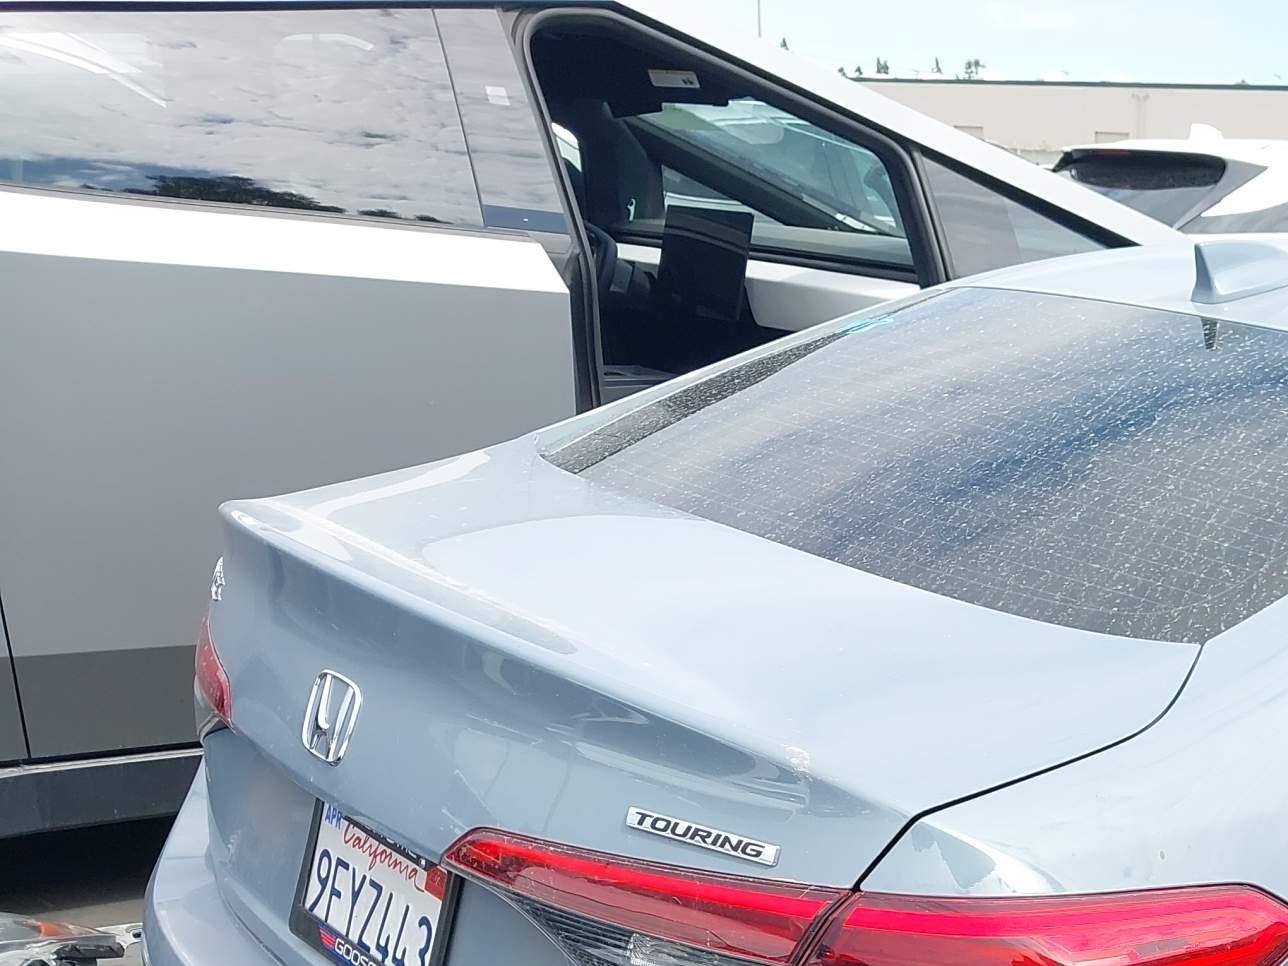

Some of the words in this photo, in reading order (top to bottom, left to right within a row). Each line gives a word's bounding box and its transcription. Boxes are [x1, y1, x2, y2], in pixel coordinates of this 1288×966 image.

[324, 804, 343, 829] APR
[635, 811, 766, 858] TOURING
[342, 821, 425, 893] California
